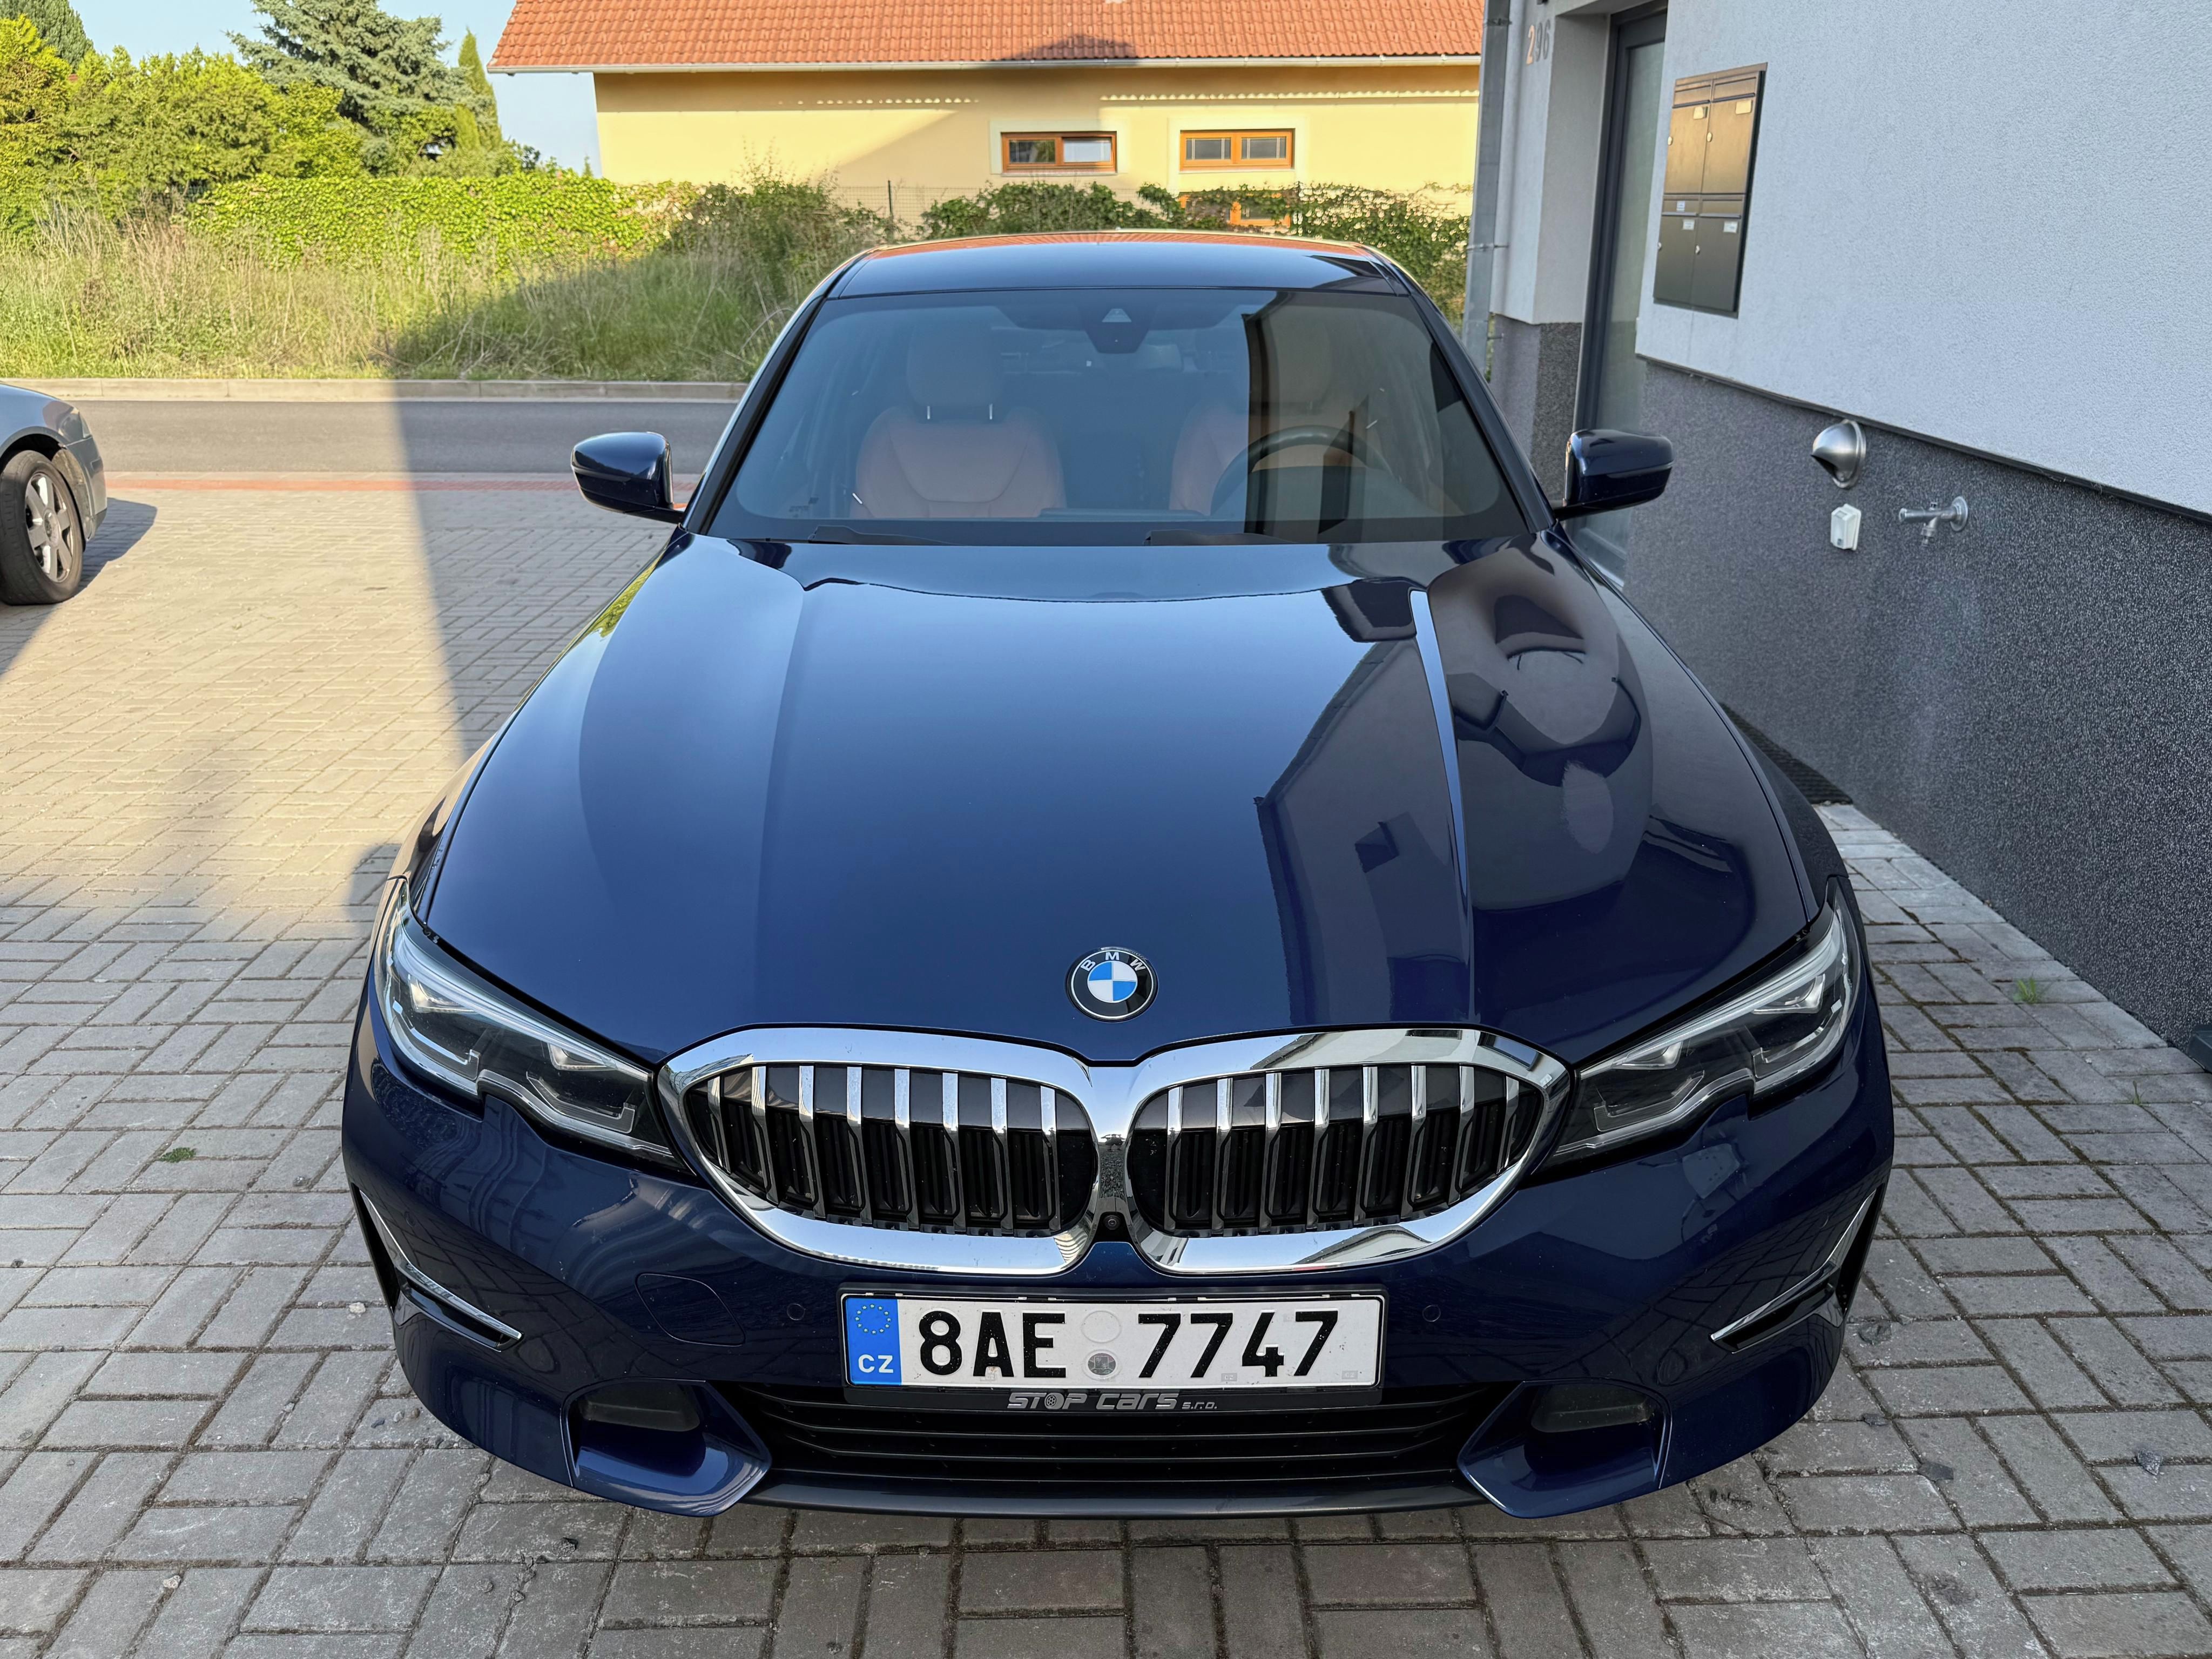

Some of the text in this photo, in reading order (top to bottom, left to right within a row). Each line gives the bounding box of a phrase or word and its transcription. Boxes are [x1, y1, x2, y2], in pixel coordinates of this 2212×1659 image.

[1526, 19, 1550, 65] 296
[1080, 952, 1146, 972] BMW
[919, 1310, 1339, 1378] 8AE 7747
[858, 1354, 894, 1373] CZ
[1007, 1392, 1088, 1410] STOP
[1182, 1401, 1217, 1410] s.r.o.
